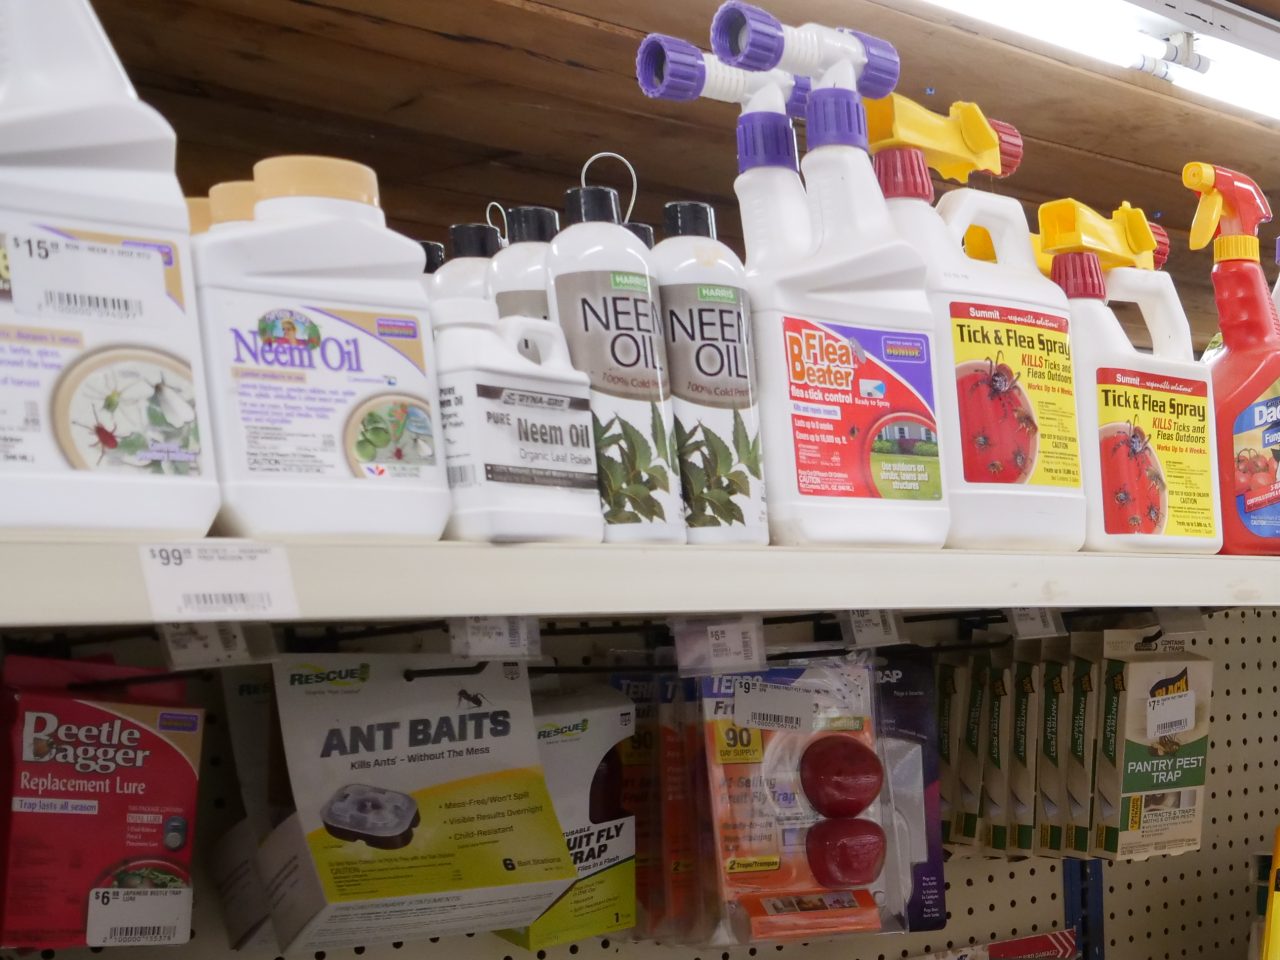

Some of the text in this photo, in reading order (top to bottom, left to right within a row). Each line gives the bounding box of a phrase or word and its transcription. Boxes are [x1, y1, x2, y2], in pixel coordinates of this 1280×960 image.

[702, 290, 734, 298] HARRIS
[229, 328, 363, 373] Neem Oil
[611, 333, 663, 371] OIL
[957, 324, 1071, 360] Tick & Flea Spray
[695, 343, 748, 379] OIL
[1102, 389, 1206, 422] Tick & Flea Spray
[486, 411, 512, 425] PURE
[1152, 417, 1205, 434] KILLS Ticks and
[517, 418, 590, 448] Neem Oil
[1157, 431, 1206, 444] Fleas Outdoors
[319, 710, 512, 758] ANT BAITS
[725, 727, 751, 747] 90
[350, 760, 372, 771] Kills
[407, 750, 444, 764] Without
[446, 747, 464, 758] The
[466, 746, 490, 756] Mess
[1127, 756, 1205, 774] PANTRY PEST
[20, 771, 146, 794] Replacement Lure
[1151, 770, 1182, 784] TRAP
[18, 800, 96, 812] Trap lasts all season
[721, 789, 796, 804] Fruit Fly Trap
[449, 805, 543, 825] Visible Results Overnight
[454, 825, 514, 841] Child-Resistant
[597, 823, 625, 845] FLY
